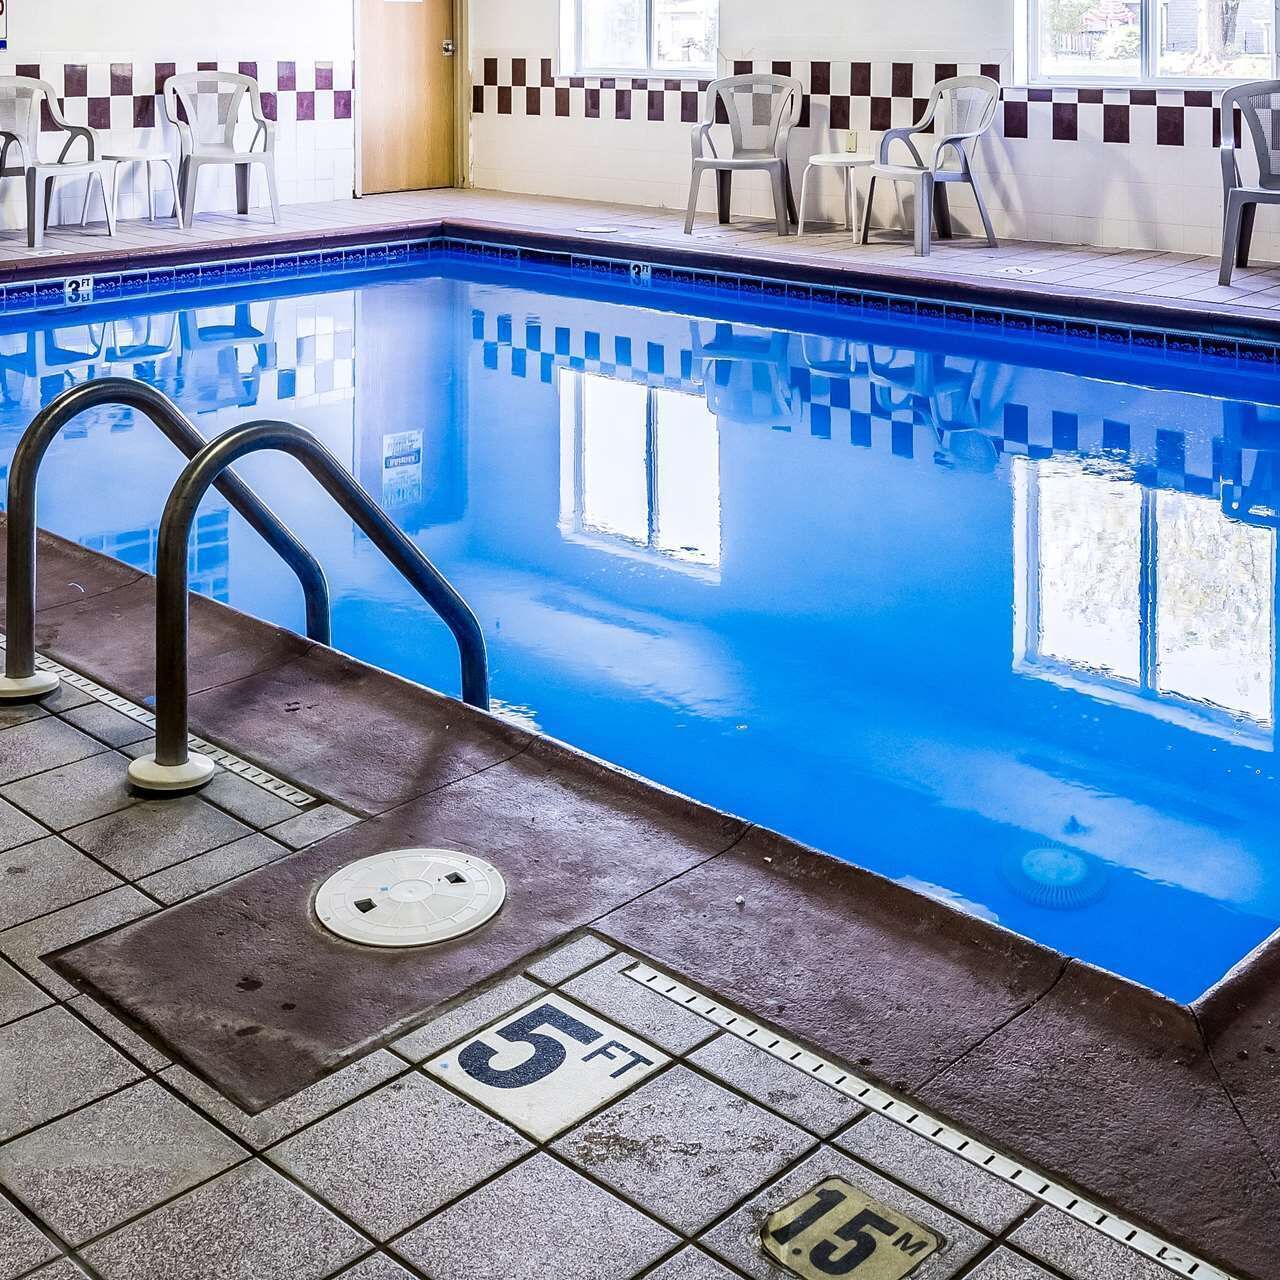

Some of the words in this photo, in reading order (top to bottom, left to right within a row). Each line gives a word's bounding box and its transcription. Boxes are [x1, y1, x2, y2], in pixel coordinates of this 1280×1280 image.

[67, 280, 81, 302] 3
[81, 278, 91, 287] FT
[458, 1003, 604, 1089] 5
[581, 1039, 655, 1079] FT
[770, 1188, 900, 1275] 1.5
[891, 1231, 929, 1257] M
